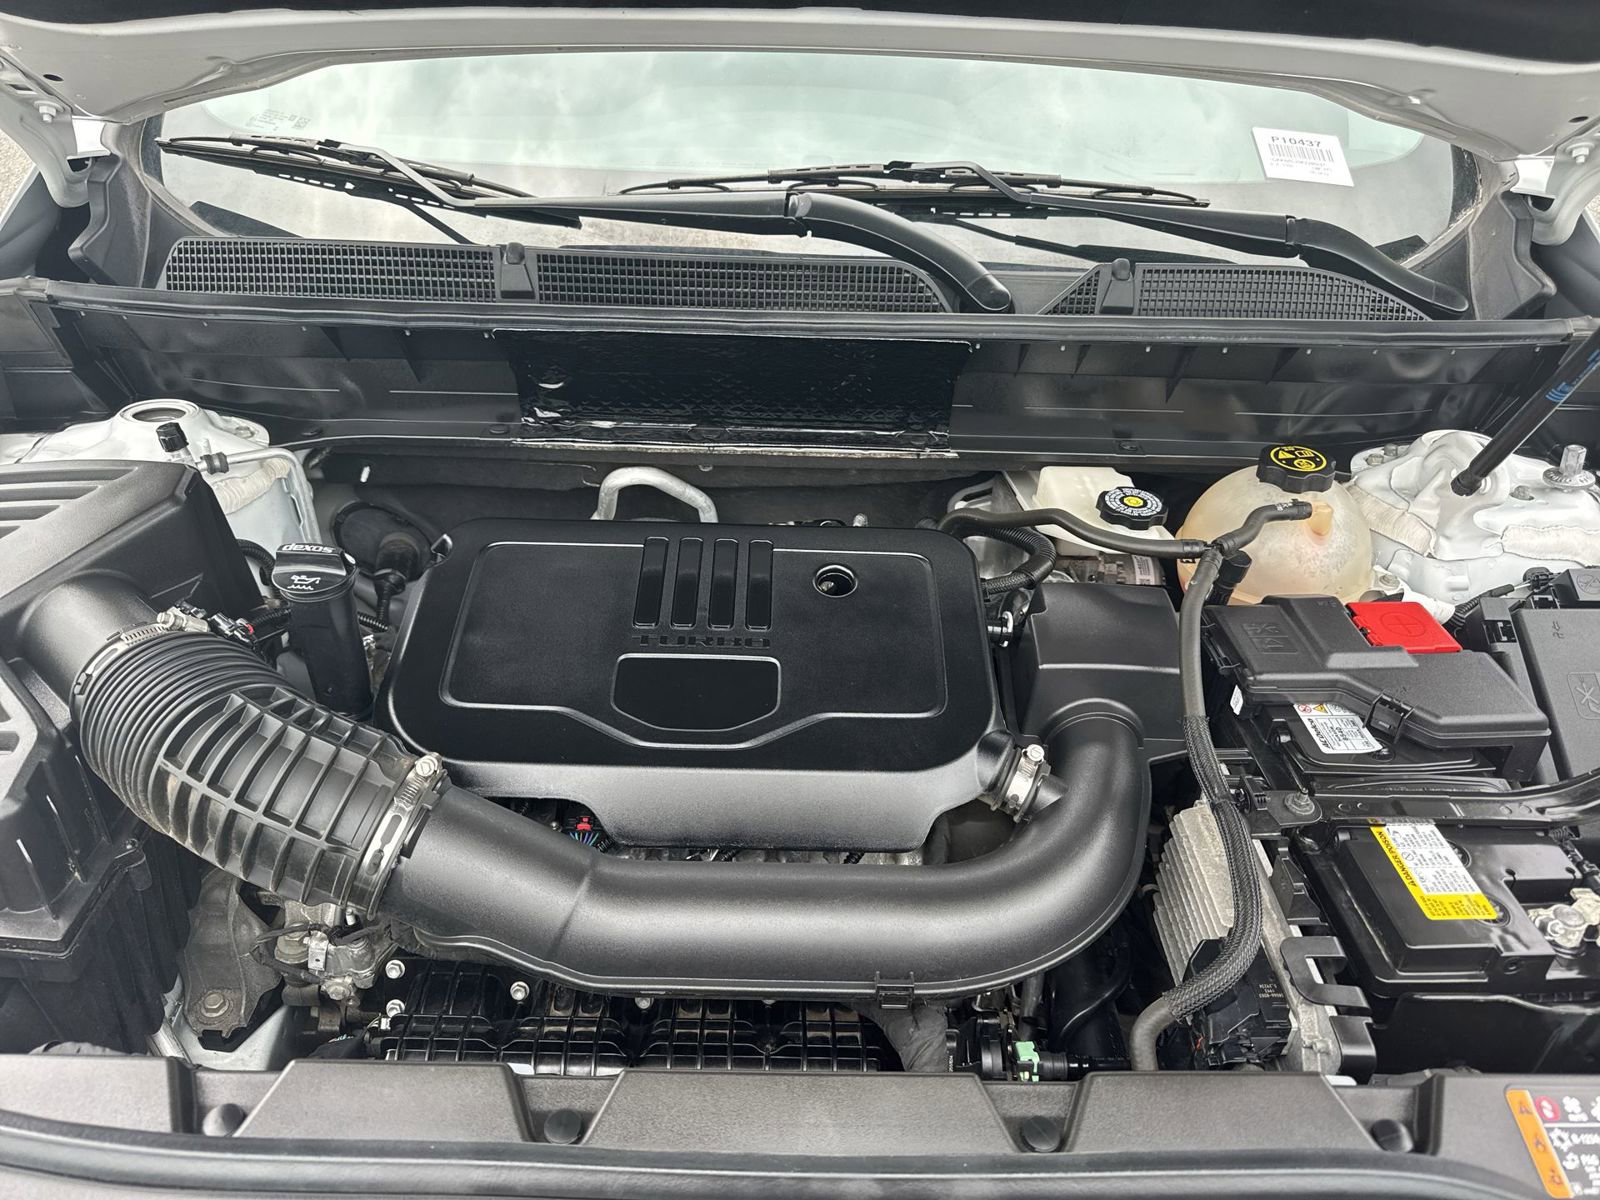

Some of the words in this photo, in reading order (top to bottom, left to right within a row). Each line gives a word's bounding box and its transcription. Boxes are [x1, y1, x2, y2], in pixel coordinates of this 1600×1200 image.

[1271, 136, 1321, 148] P10437
[282, 543, 335, 553] dexos
[632, 635, 771, 649] TURBO
[1307, 718, 1331, 749] ACDelco
[1377, 831, 1395, 855] POISON
[1392, 855, 1413, 881] DANGER
